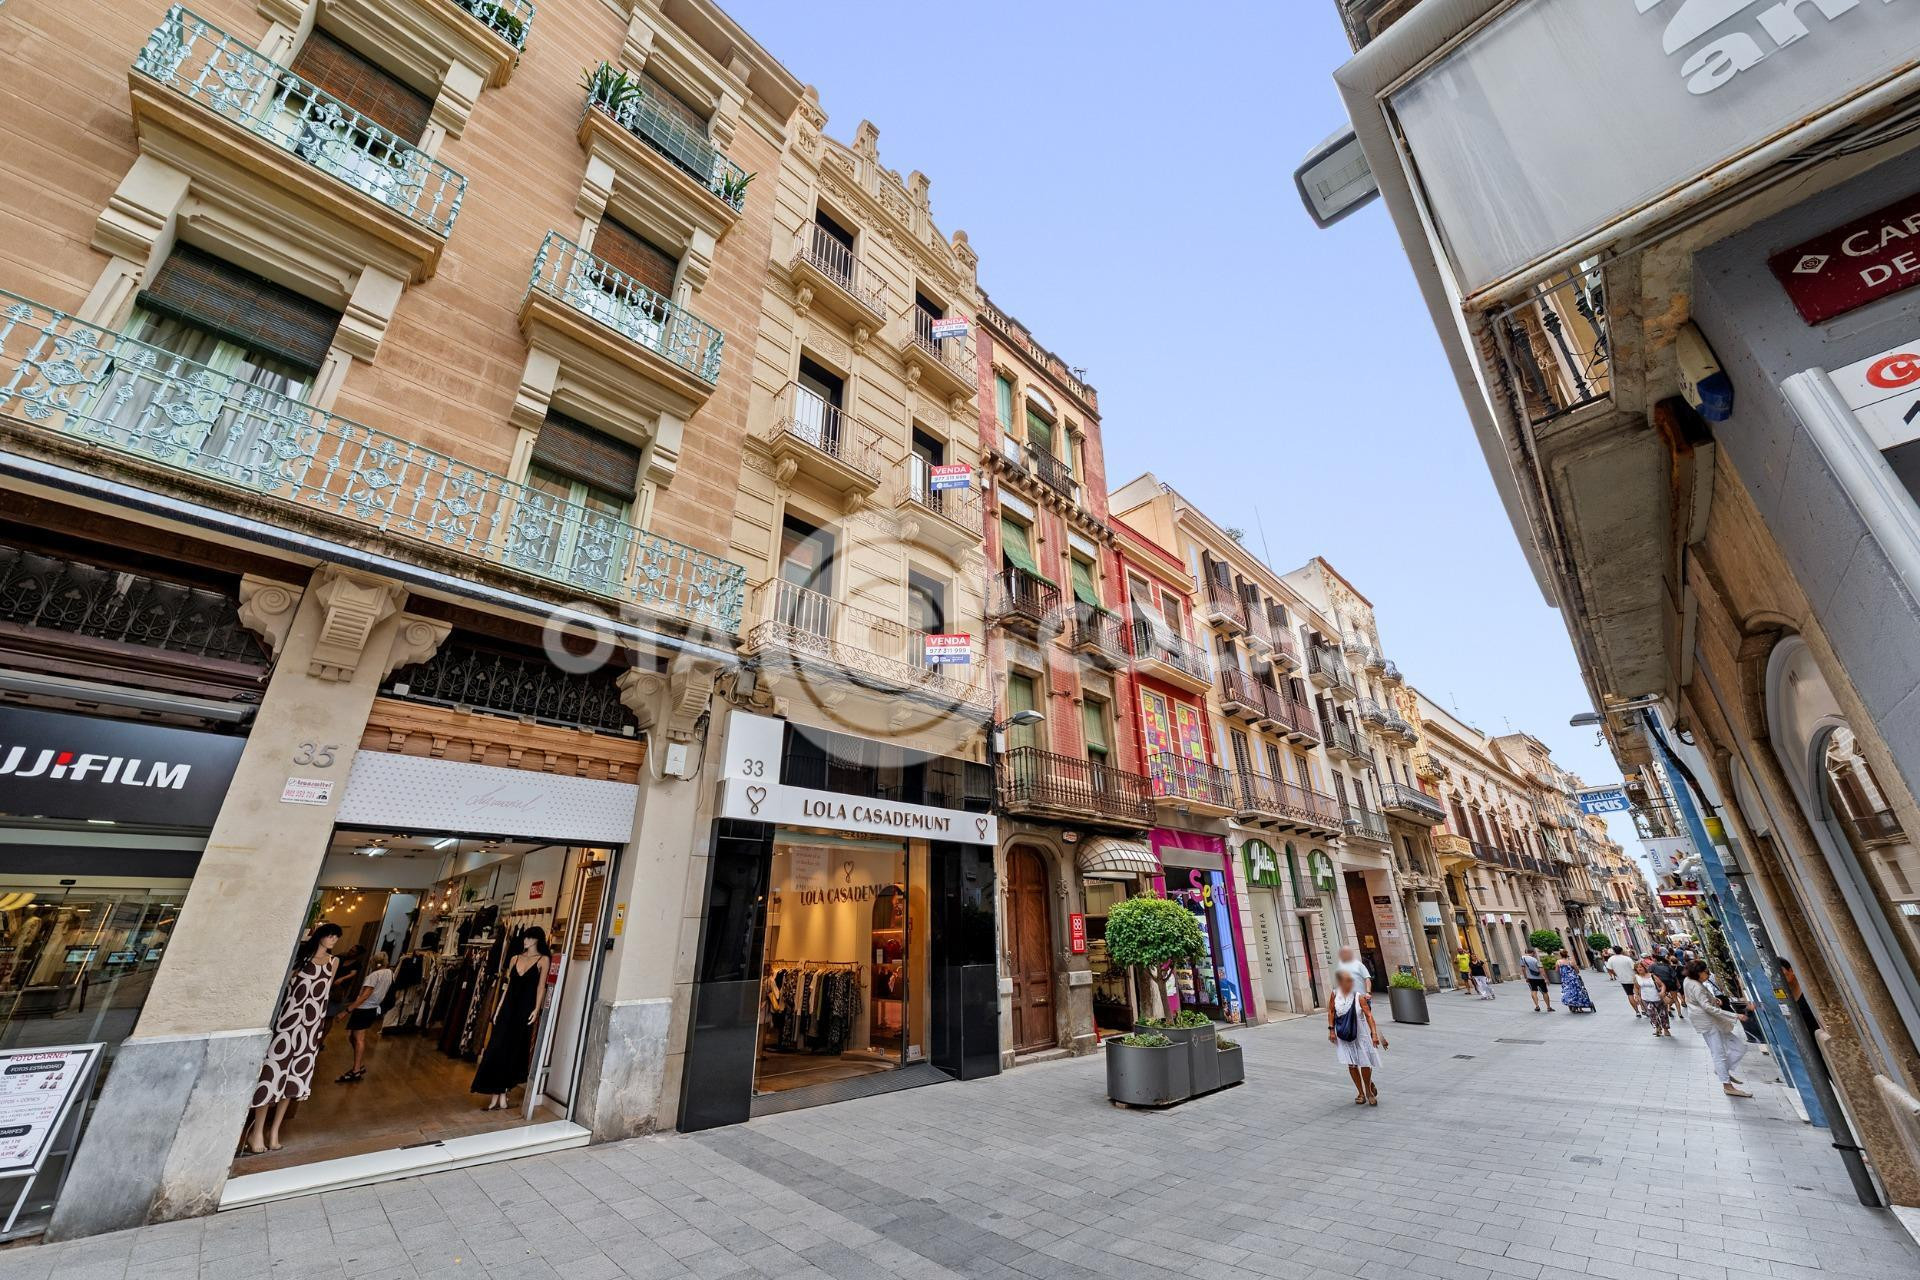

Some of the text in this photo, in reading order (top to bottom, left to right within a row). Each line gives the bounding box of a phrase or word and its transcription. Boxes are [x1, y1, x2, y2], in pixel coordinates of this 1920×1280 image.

[936, 318, 965, 326] VENDA
[935, 466, 967, 475] VENDA
[930, 636, 967, 646] VENDA
[293, 743, 339, 768] 35
[742, 758, 764, 777] 33
[1586, 799, 1623, 813] reus
[803, 800, 951, 832] LOLA CASADEMUNT
[800, 886, 825, 906] LOLA
[1259, 912, 1273, 973] PERFUMERIA
[10, 1051, 73, 1062] FOTO CARNET
